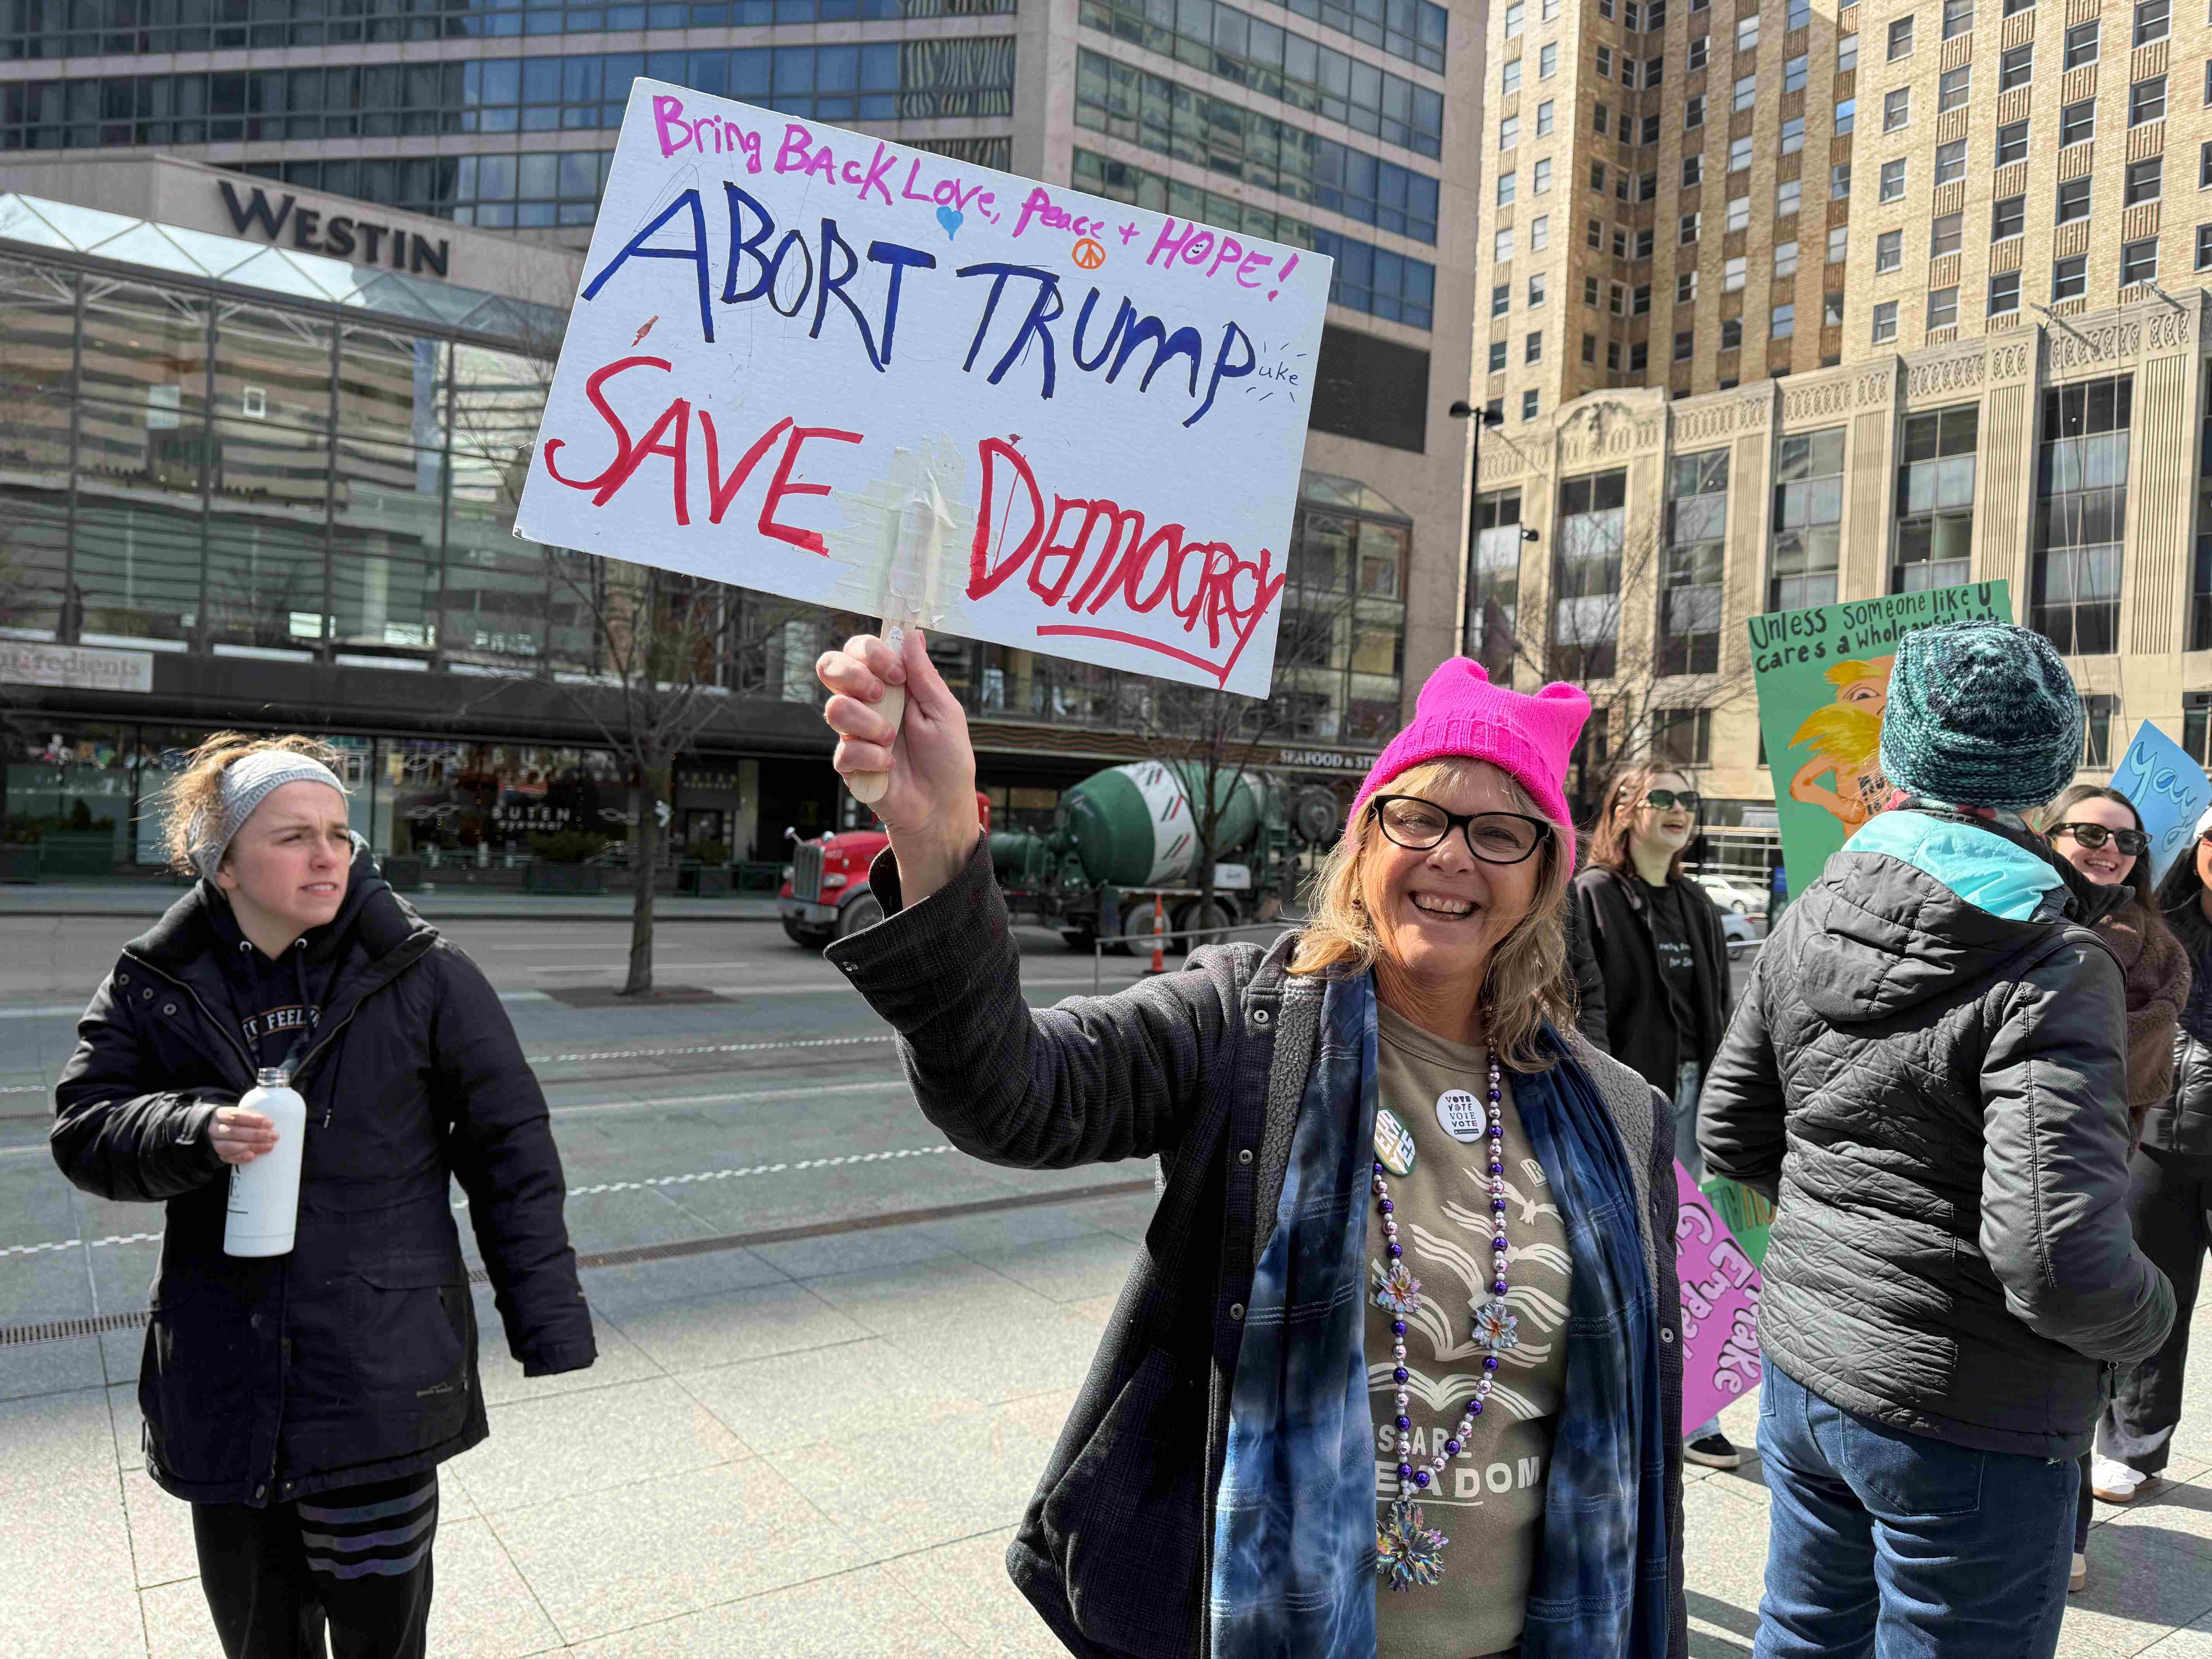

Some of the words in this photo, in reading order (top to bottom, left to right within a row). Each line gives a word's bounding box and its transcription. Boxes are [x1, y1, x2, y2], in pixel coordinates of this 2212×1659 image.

[218, 180, 450, 276] WESTIN
[653, 95, 761, 174] Bring
[1146, 217, 1299, 302] HOPE!
[582, 180, 936, 372] ABORT
[544, 356, 864, 558] SAVE
[1749, 608, 1827, 649] Unless
[1978, 583, 1991, 606] U
[1756, 641, 1826, 673] cares
[1837, 635, 1850, 654] a
[1281, 749, 1344, 767] SEAFOOD
[1449, 1112, 1476, 1120] VOTE
